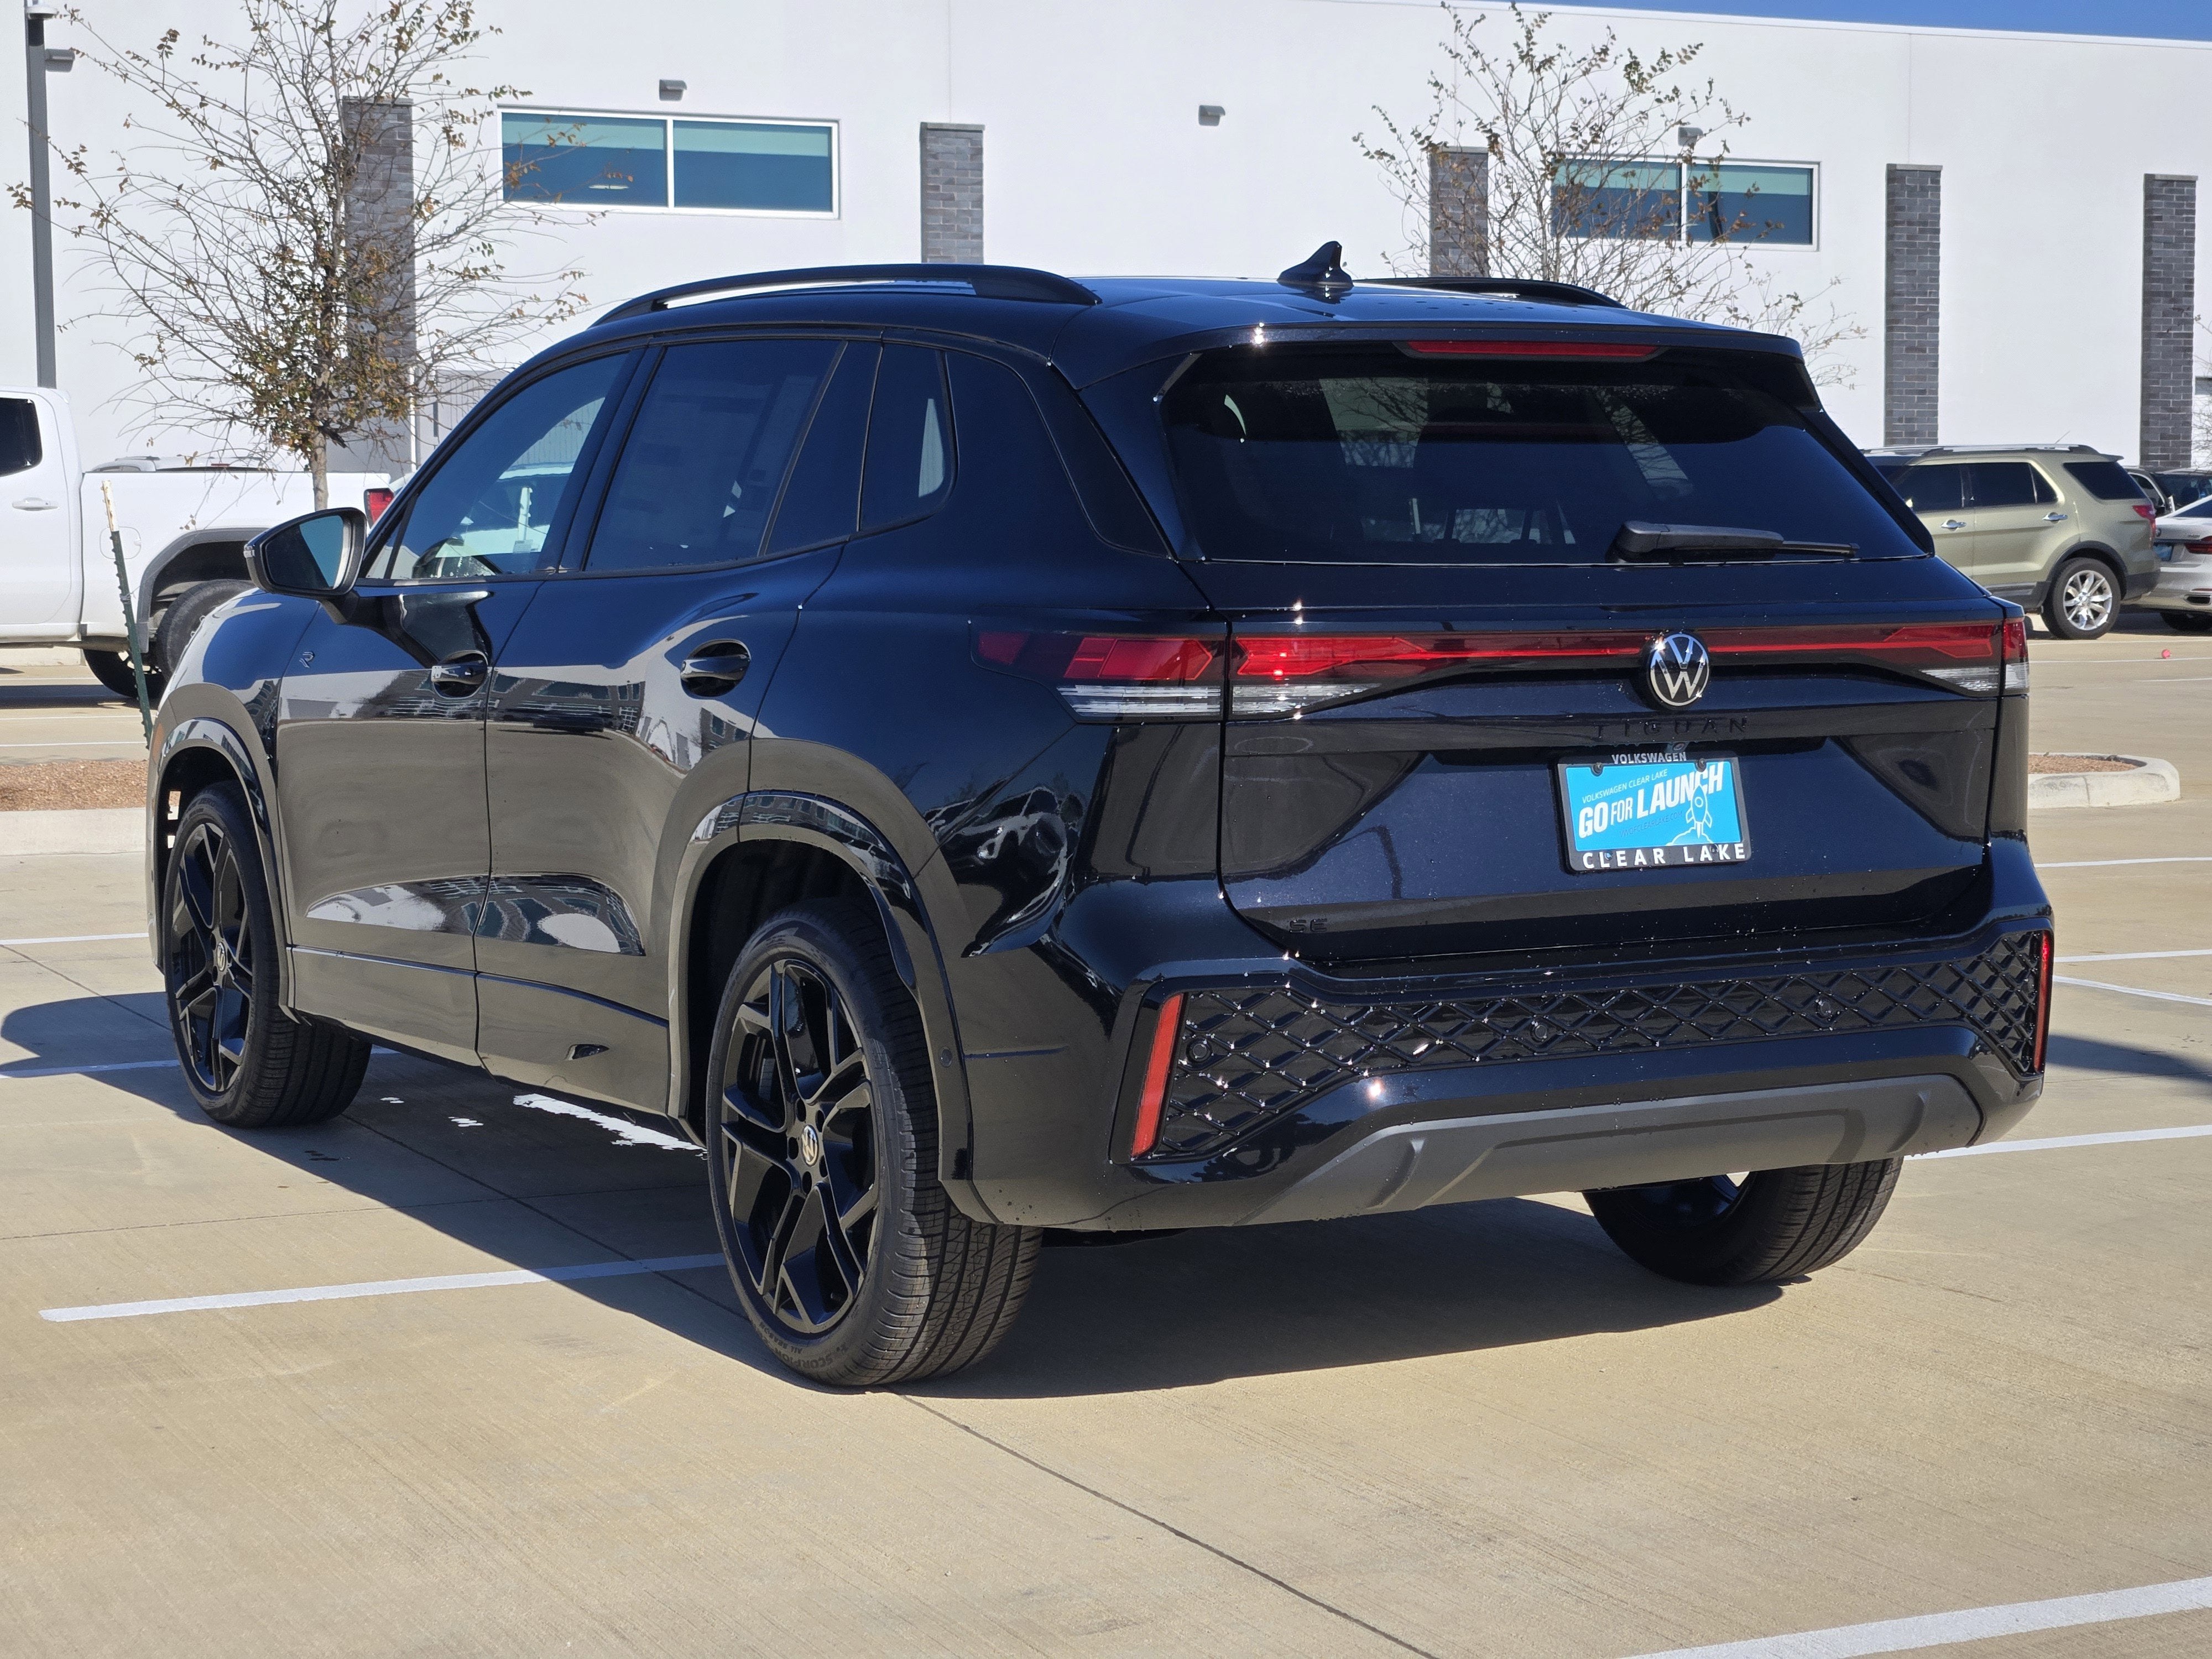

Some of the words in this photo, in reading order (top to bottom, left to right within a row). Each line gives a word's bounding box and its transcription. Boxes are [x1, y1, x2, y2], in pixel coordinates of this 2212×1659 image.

[1593, 717, 1747, 738] TIGUAN
[1611, 751, 1687, 764] VOLKSWAGEN
[1582, 782, 1627, 804] VOLKSWAGEN
[1629, 775, 1650, 789] CLEAR
[1651, 769, 1668, 781] LAKE
[1579, 801, 1608, 839] GO
[1610, 797, 1633, 826] FOR
[1637, 761, 1724, 819] LAUNCH
[1583, 848, 1666, 869] CLEAR
[1683, 843, 1745, 862] LAKE
[1290, 919, 1328, 933] SE
